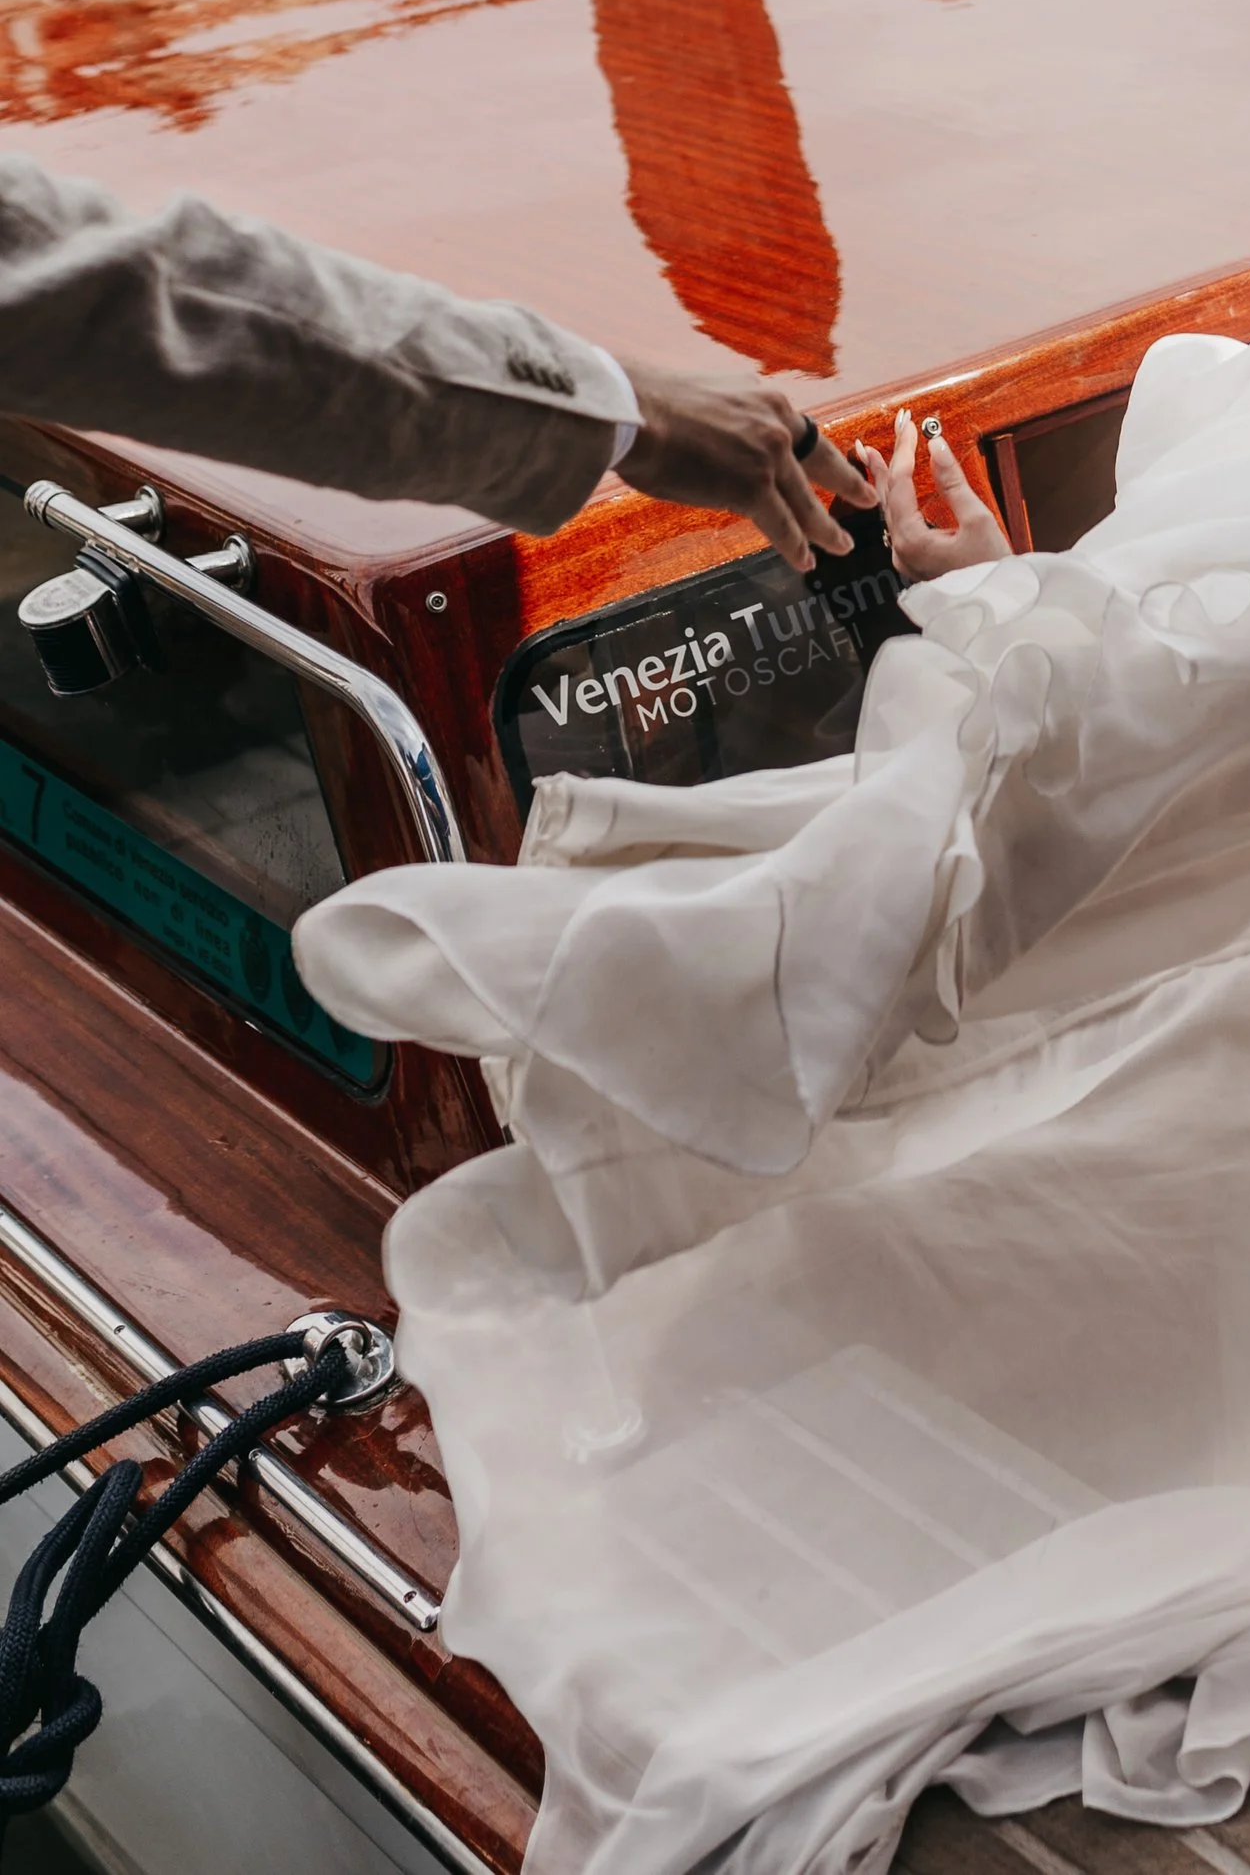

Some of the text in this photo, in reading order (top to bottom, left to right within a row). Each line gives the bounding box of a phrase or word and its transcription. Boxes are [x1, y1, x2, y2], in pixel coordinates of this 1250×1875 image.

[531, 568, 910, 726] Venezia Turism
[636, 623, 864, 732] MOTOSCAFI
[62, 800, 112, 845] Comune
[128, 843, 177, 892] Venezia
[179, 882, 230, 928] servizio
[66, 832, 125, 883] pubblico
[195, 916, 231, 957] linea
